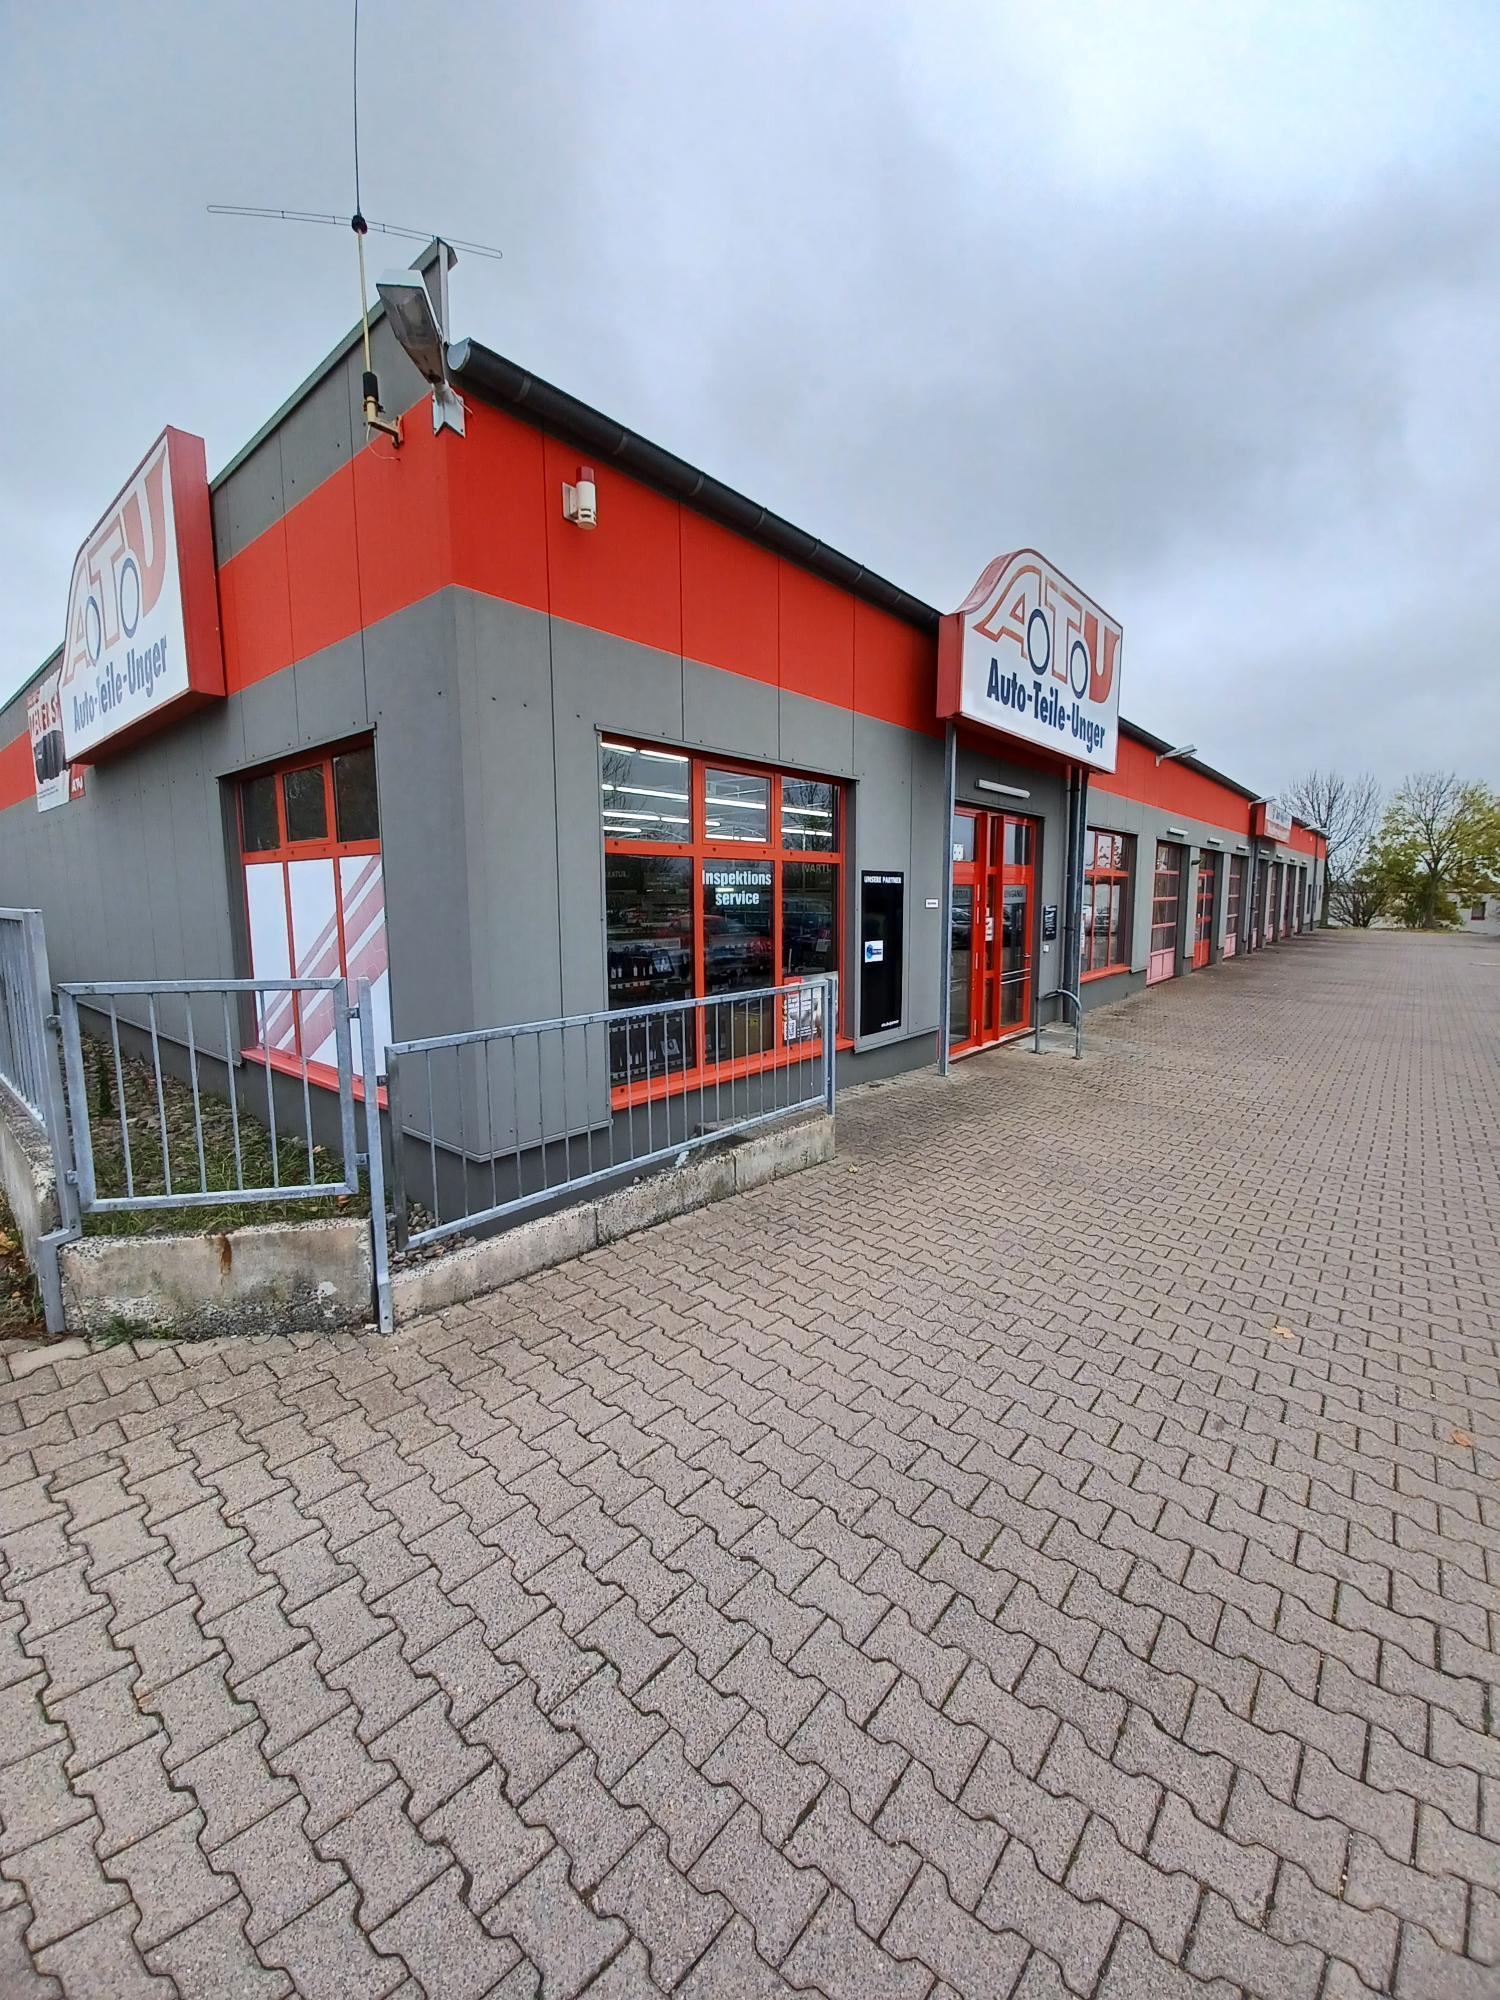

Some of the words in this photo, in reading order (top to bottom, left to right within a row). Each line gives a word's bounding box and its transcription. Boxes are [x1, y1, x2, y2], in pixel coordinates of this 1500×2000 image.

[63, 444, 166, 686] ATU
[972, 565, 1120, 704] ATU
[987, 657, 1106, 753] Auto-Teile-Unger
[702, 869, 772, 886] Inspektions
[715, 890, 760, 906] service
